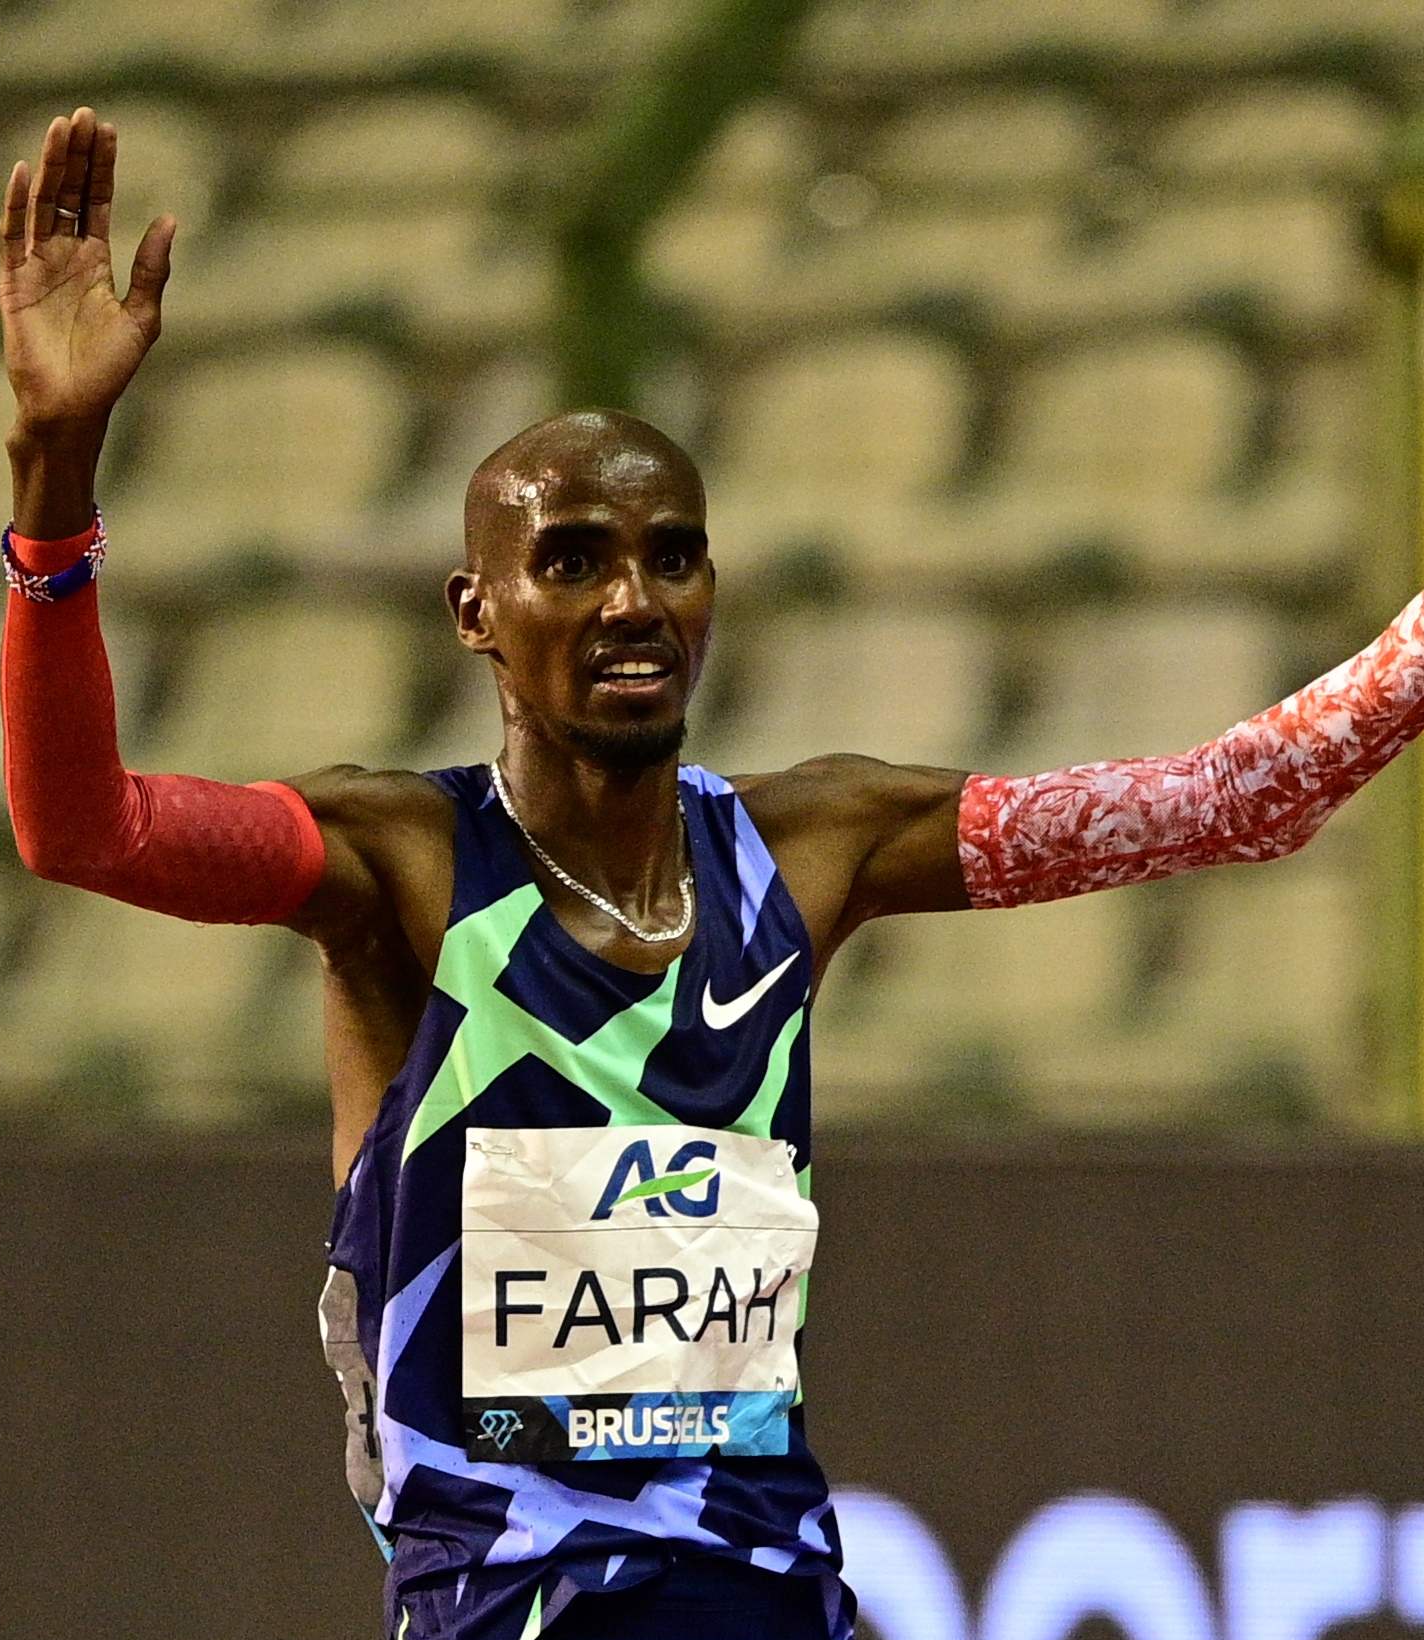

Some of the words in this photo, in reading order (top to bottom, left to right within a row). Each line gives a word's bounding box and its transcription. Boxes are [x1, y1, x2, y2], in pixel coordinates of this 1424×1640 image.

[590, 1139, 721, 1221] AG
[494, 1267, 792, 1349] FARAH
[568, 1405, 731, 1448] BRUSSELS
